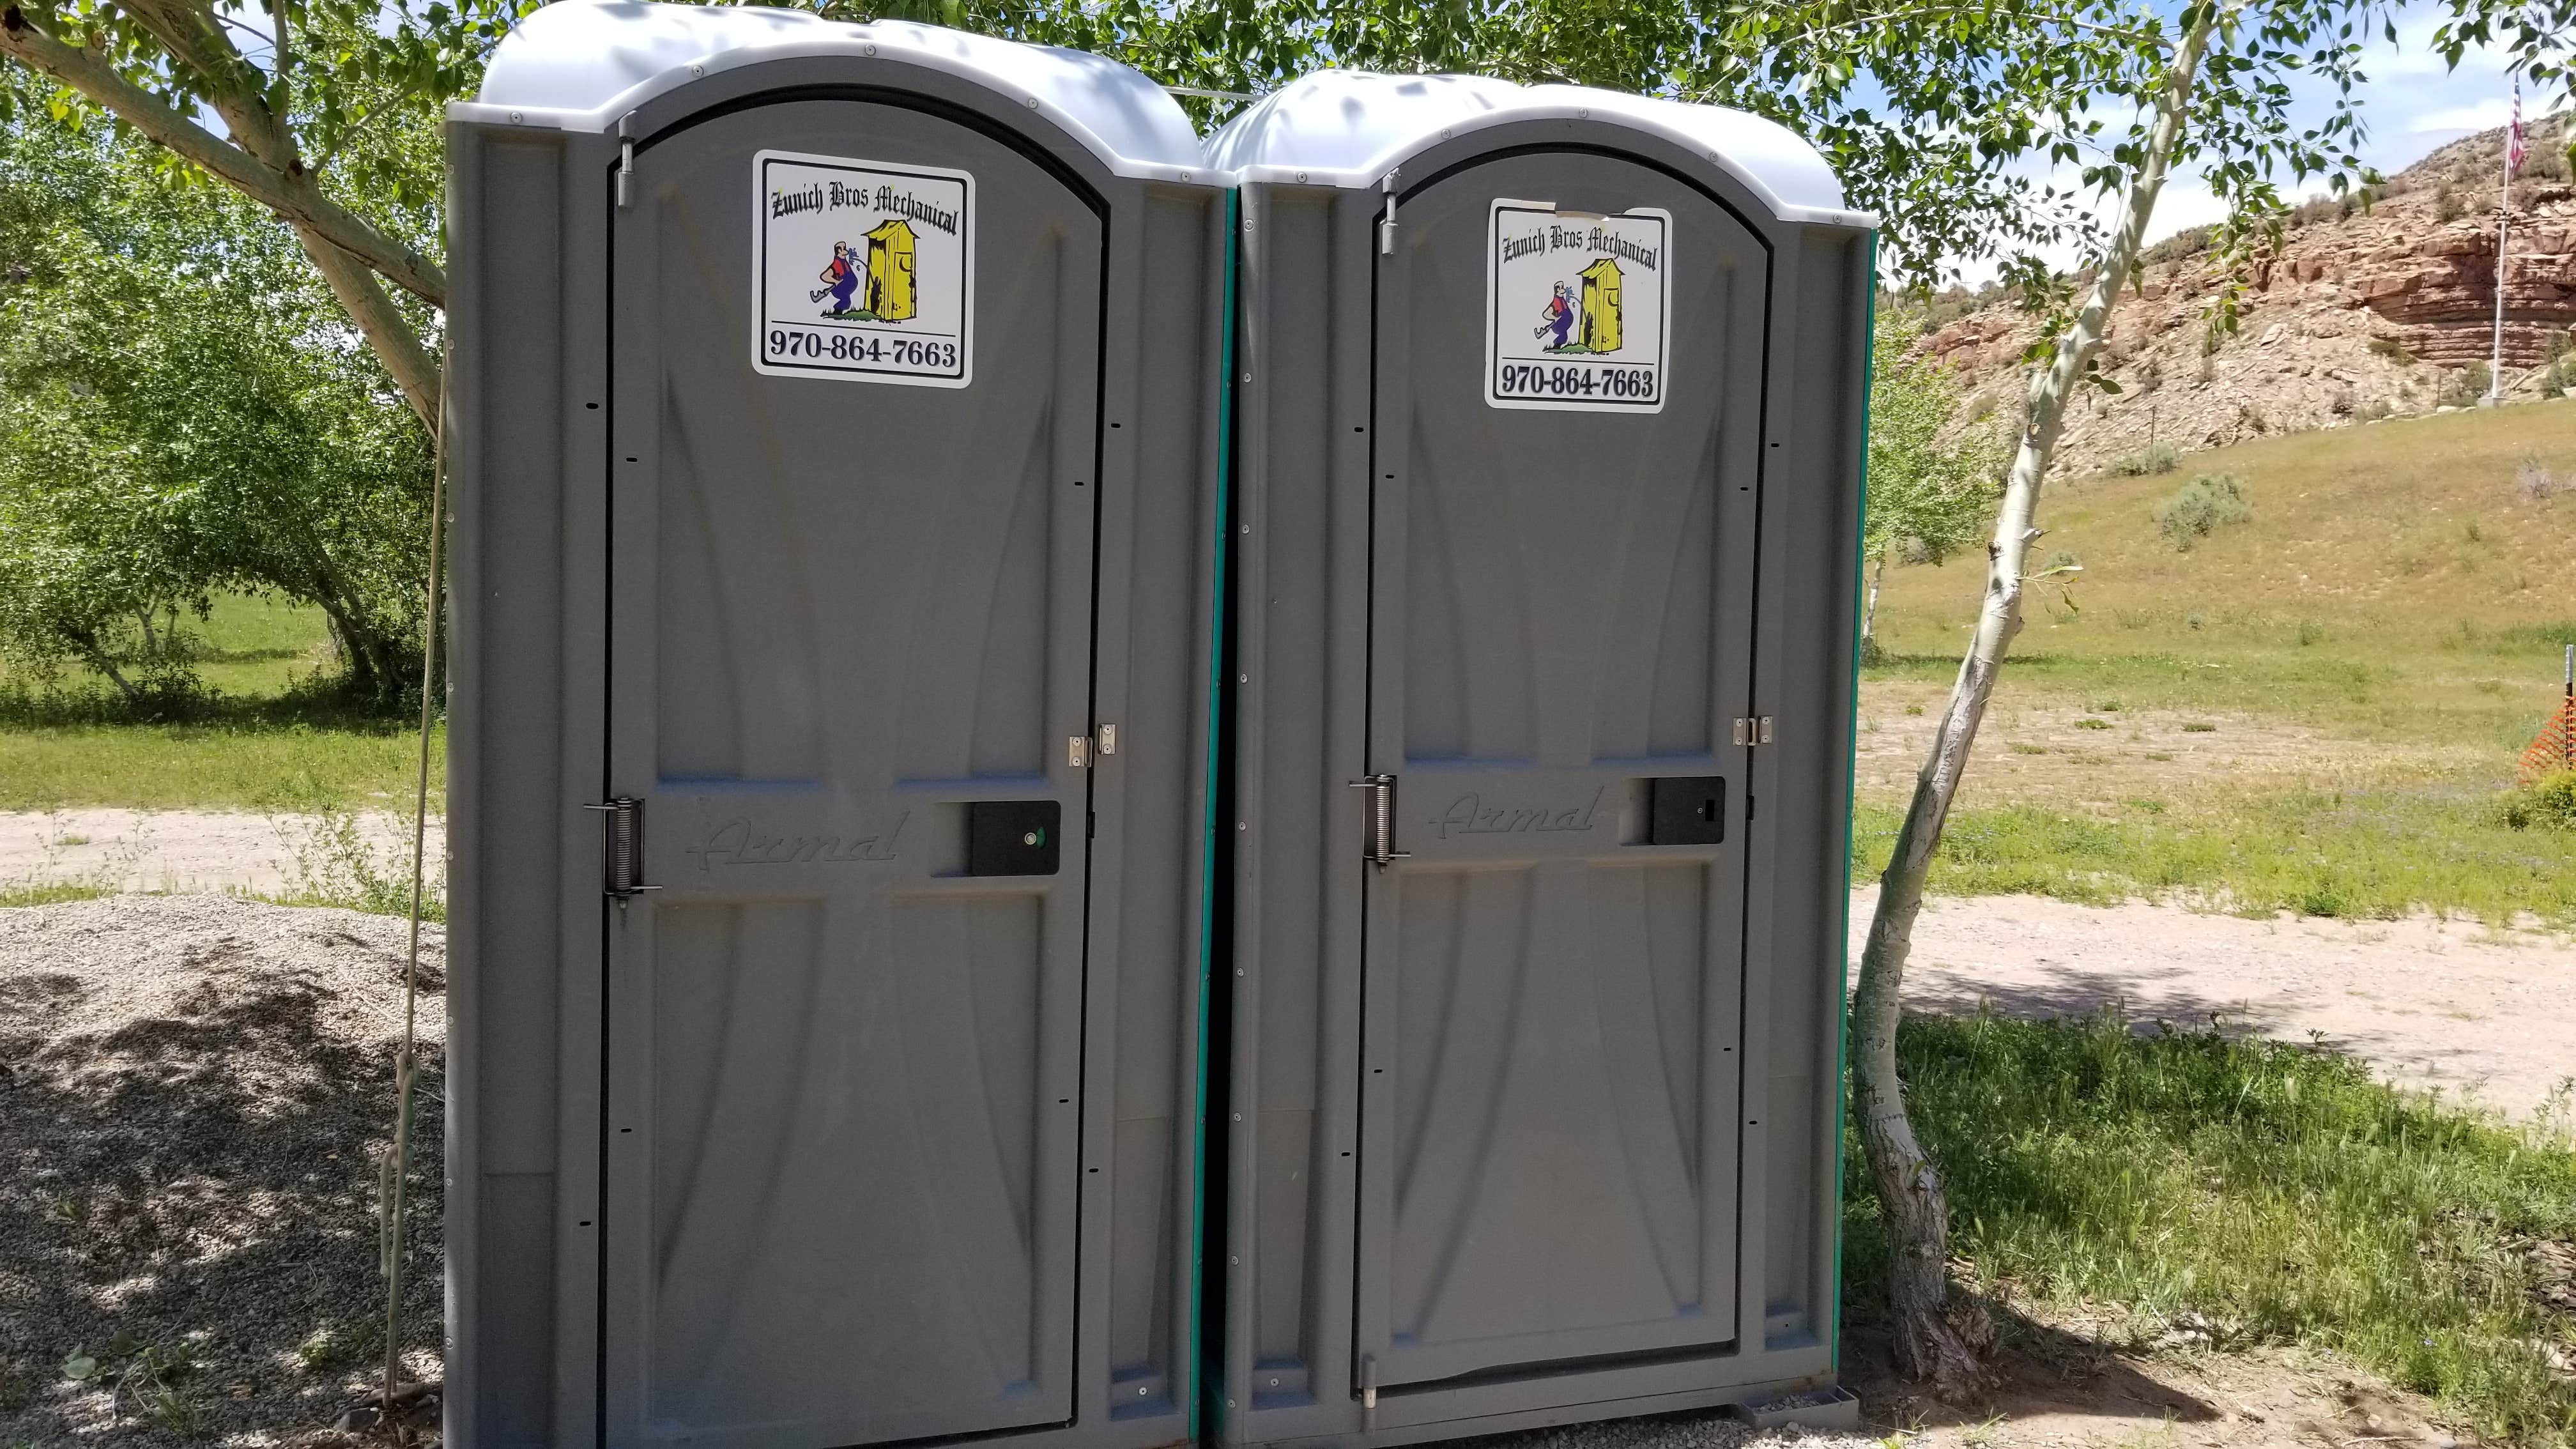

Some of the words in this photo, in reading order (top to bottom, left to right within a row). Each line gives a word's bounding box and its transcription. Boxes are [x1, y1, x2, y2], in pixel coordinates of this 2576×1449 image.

[771, 183, 824, 219] Zunich
[829, 181, 869, 211] Bros
[873, 185, 959, 236] Mechanical
[1503, 227, 1545, 263] Zunich
[1549, 225, 1583, 254] Bros
[1586, 226, 1658, 272] Mechanical
[770, 330, 956, 367] 970-864-7663
[1502, 365, 1653, 397] 970-864-7663
[1428, 785, 1604, 839] Armal
[686, 809, 912, 871] Armal
